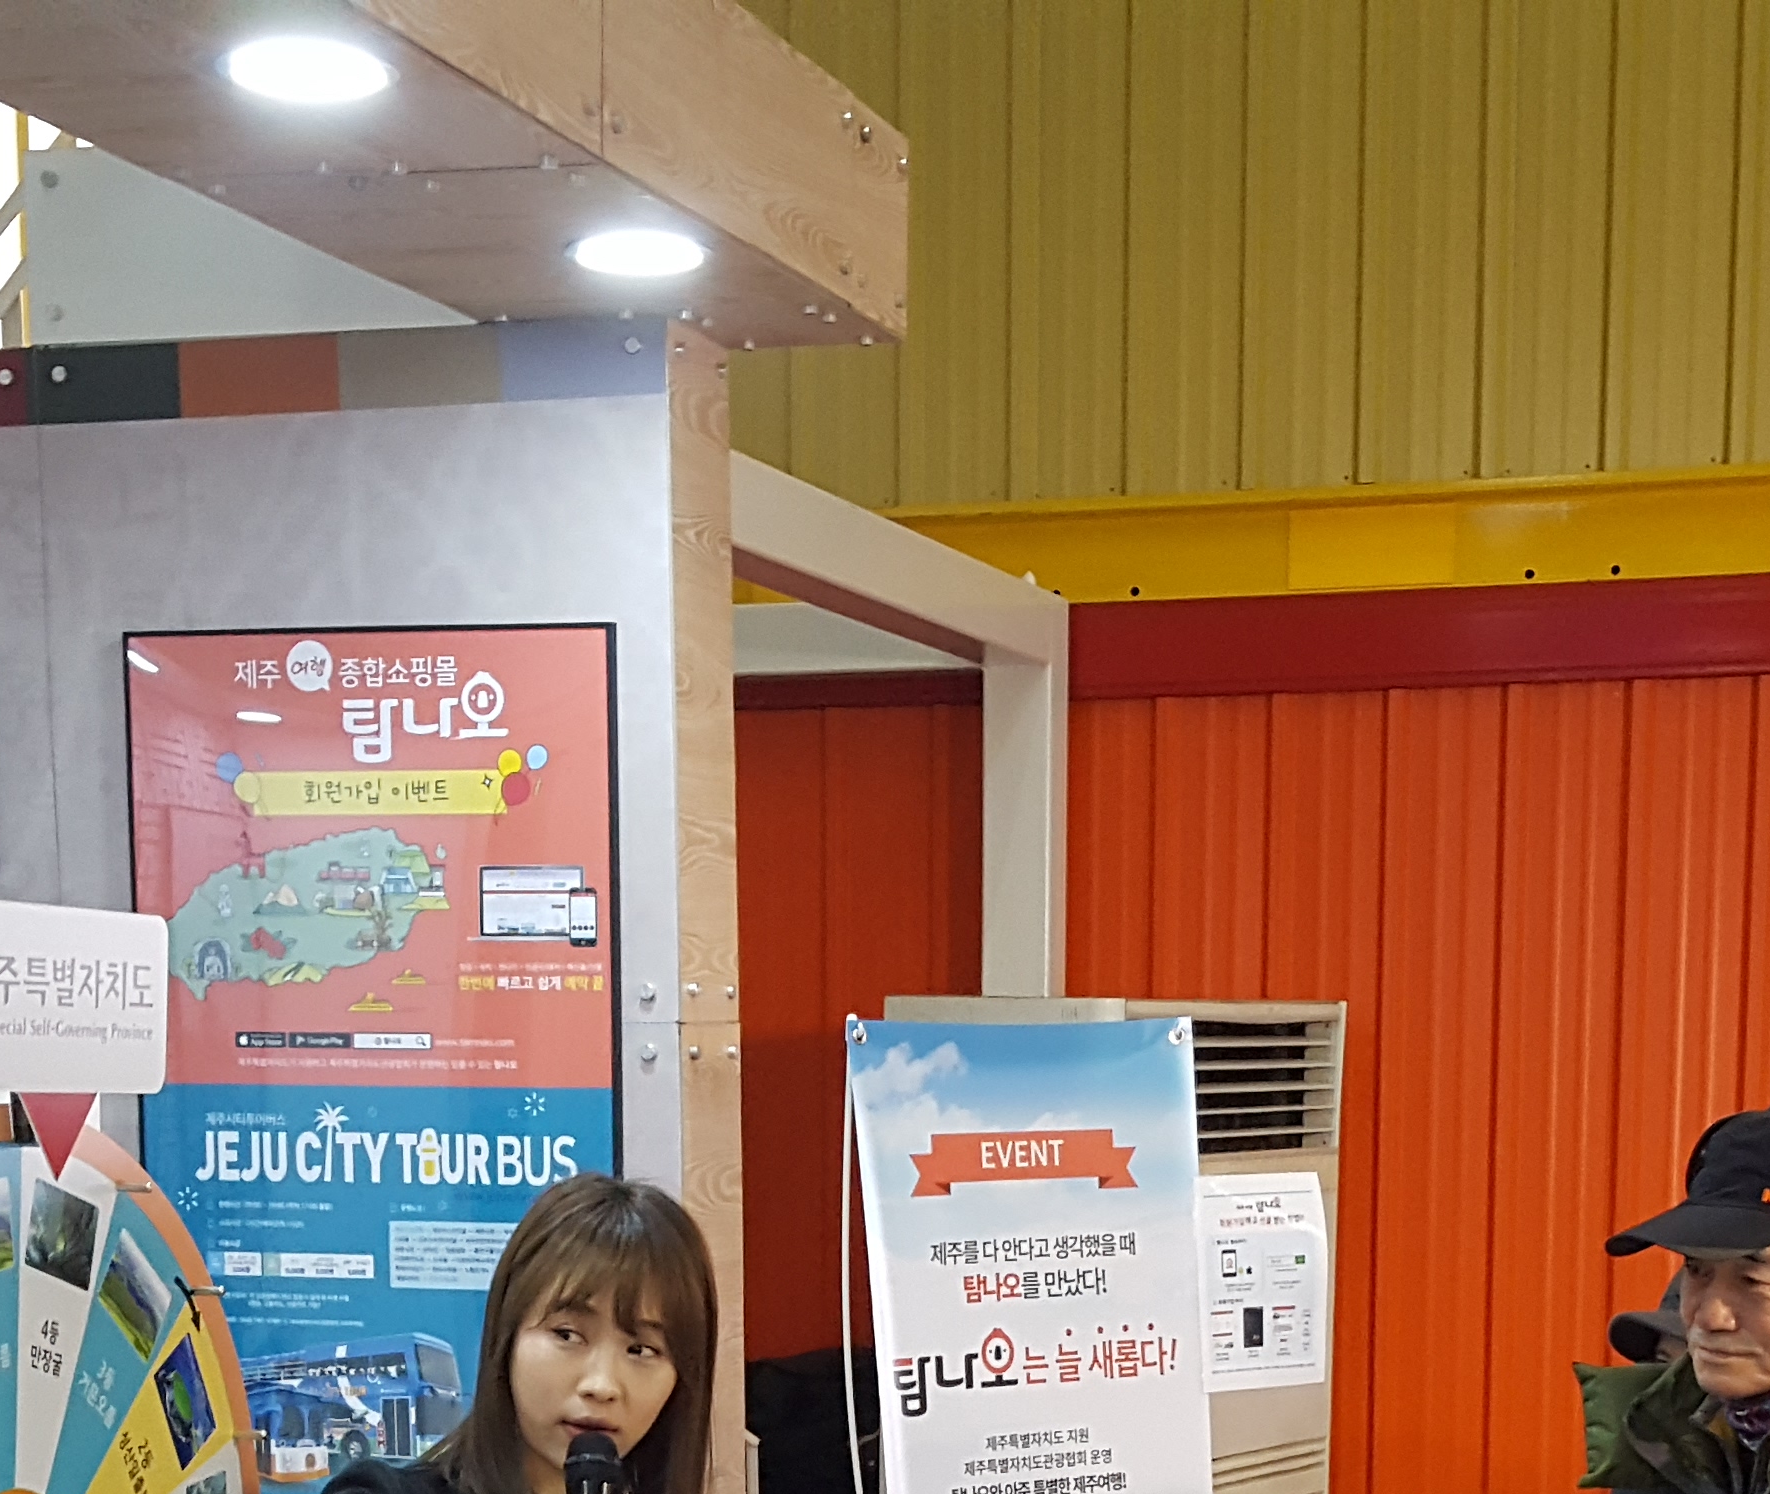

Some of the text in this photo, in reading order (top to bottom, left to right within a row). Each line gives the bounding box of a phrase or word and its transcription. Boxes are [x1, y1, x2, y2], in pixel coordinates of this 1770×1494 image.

[234, 655, 458, 690] 제주 여행 종합쇼핑몰
[341, 671, 509, 764] 탐나오
[304, 778, 450, 806] 회원가입 이벤트
[29, 1018, 108, 1043] Self-Governing
[110, 1022, 154, 1042] Province
[204, 1112, 287, 1127] 제주시티투어버스
[195, 1122, 579, 1188] JEJU CITY TOUR BUS
[980, 1139, 1065, 1170] EVENT
[930, 1232, 1137, 1265] 제주를 다 안다고 생각했을 때
[963, 1268, 1107, 1304] 탐나오를 만났다!
[40, 1319, 61, 1346] 4등
[30, 1345, 64, 1378] 만장굴
[1055, 1343, 1083, 1383] 늘
[1089, 1336, 1178, 1380] 새롭다!
[985, 1427, 1090, 1451] 제주특별자치도 지원
[963, 1448, 1113, 1477] 제주특별자치도관광협회 운영
[1073, 1471, 1128, 1494] 제주여행!
